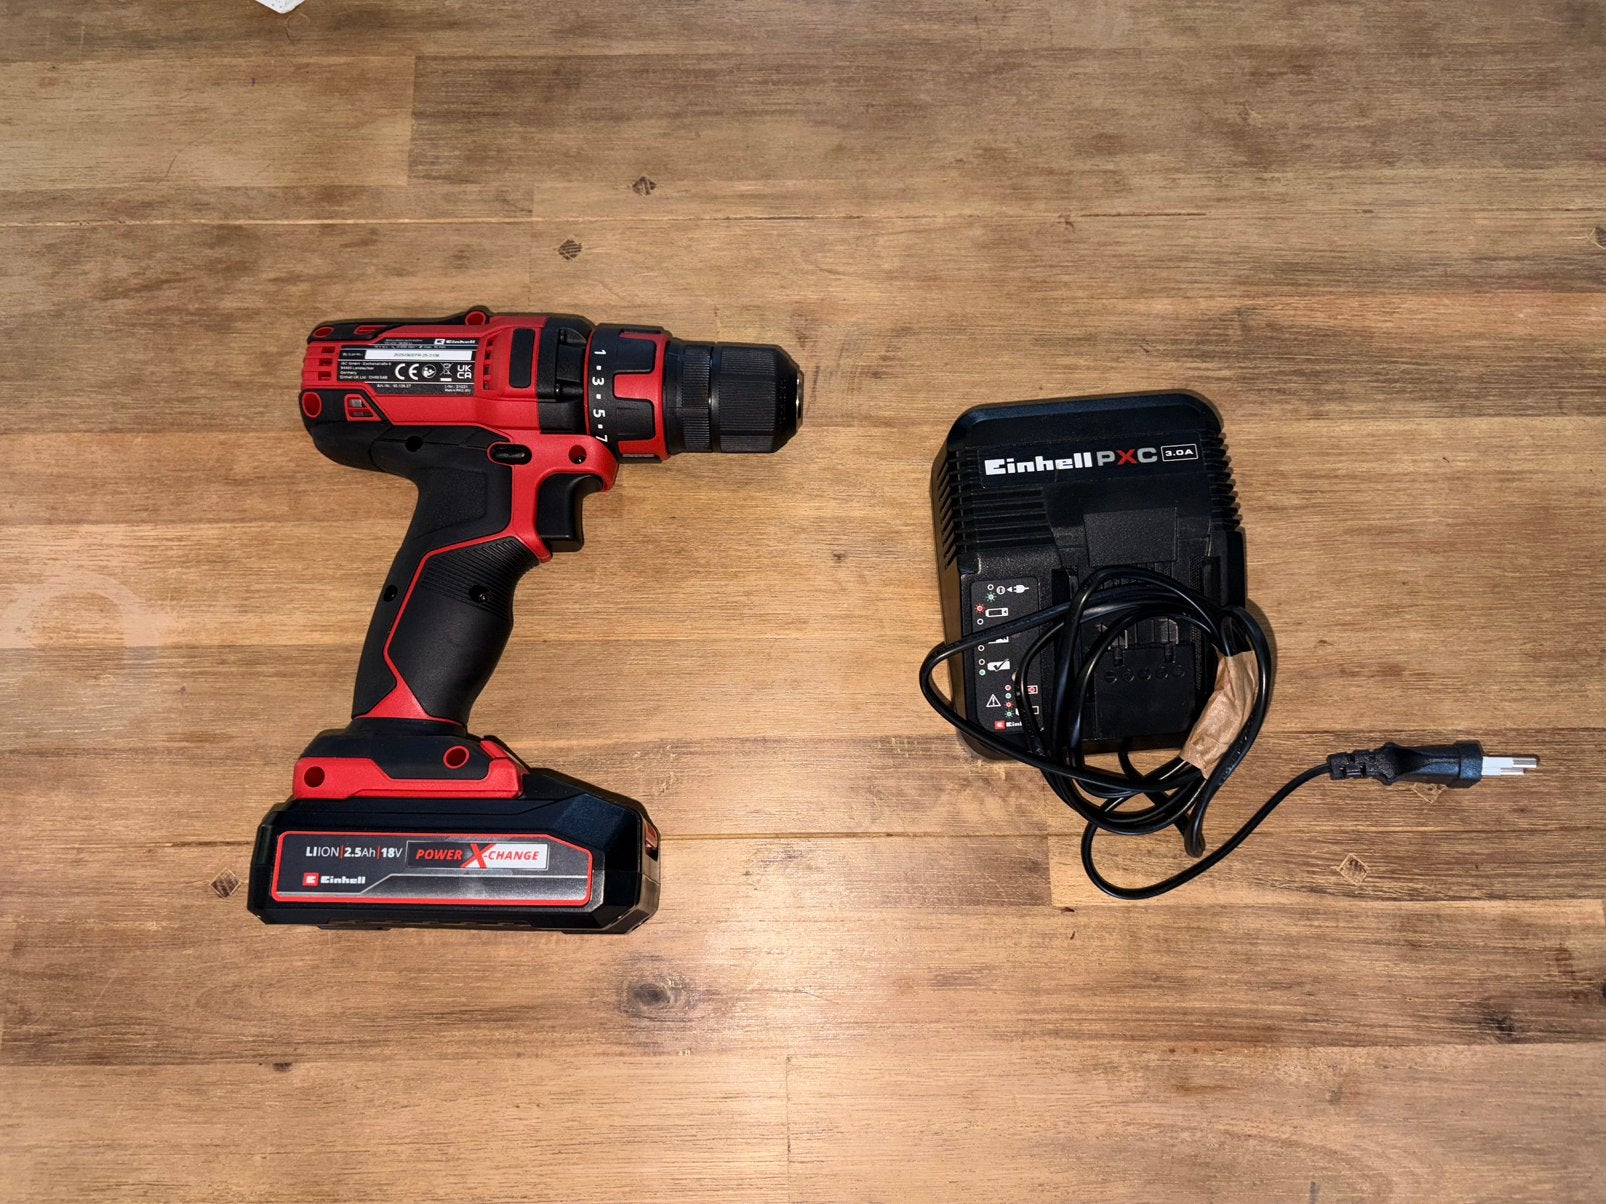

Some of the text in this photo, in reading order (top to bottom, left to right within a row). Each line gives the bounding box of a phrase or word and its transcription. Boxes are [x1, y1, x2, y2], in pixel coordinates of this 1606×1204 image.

[457, 364, 472, 372] UK
[592, 376, 605, 386] 3
[593, 408, 606, 418] 5
[984, 447, 1194, 476] Einhell PXC 3.0A
[415, 849, 463, 860] POWER
[320, 875, 366, 884] Einhell
